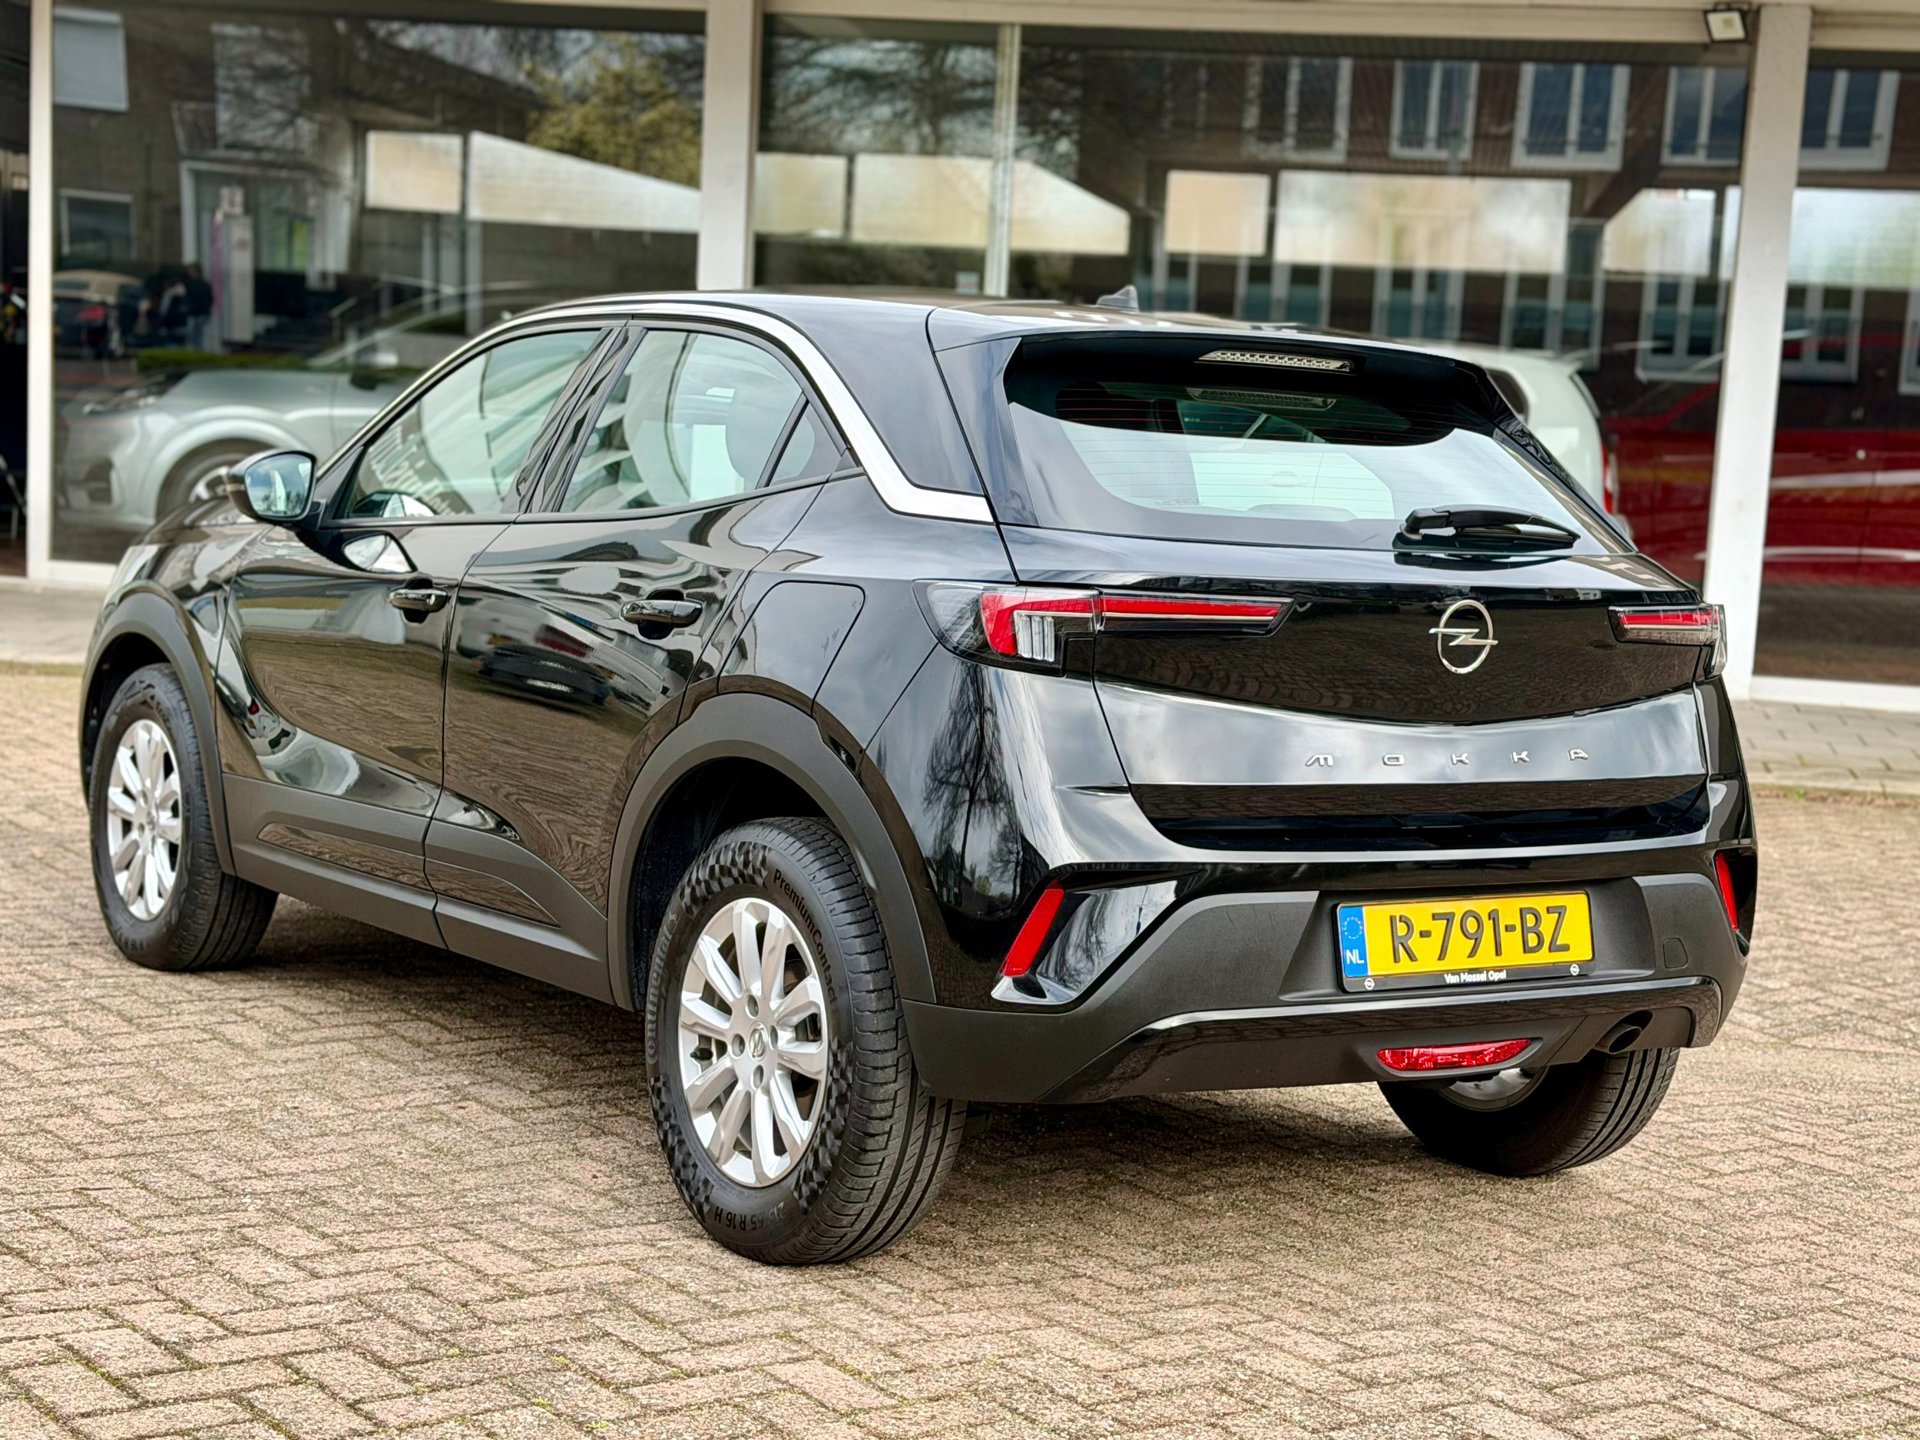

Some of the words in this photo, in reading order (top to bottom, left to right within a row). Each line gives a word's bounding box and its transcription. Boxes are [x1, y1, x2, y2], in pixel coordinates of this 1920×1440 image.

[1305, 748, 1590, 767] MOKKA
[1389, 905, 1570, 963] R-791-BZ
[1345, 948, 1365, 965] NL
[1444, 973, 1460, 984] Van
[1488, 969, 1507, 981] Opel
